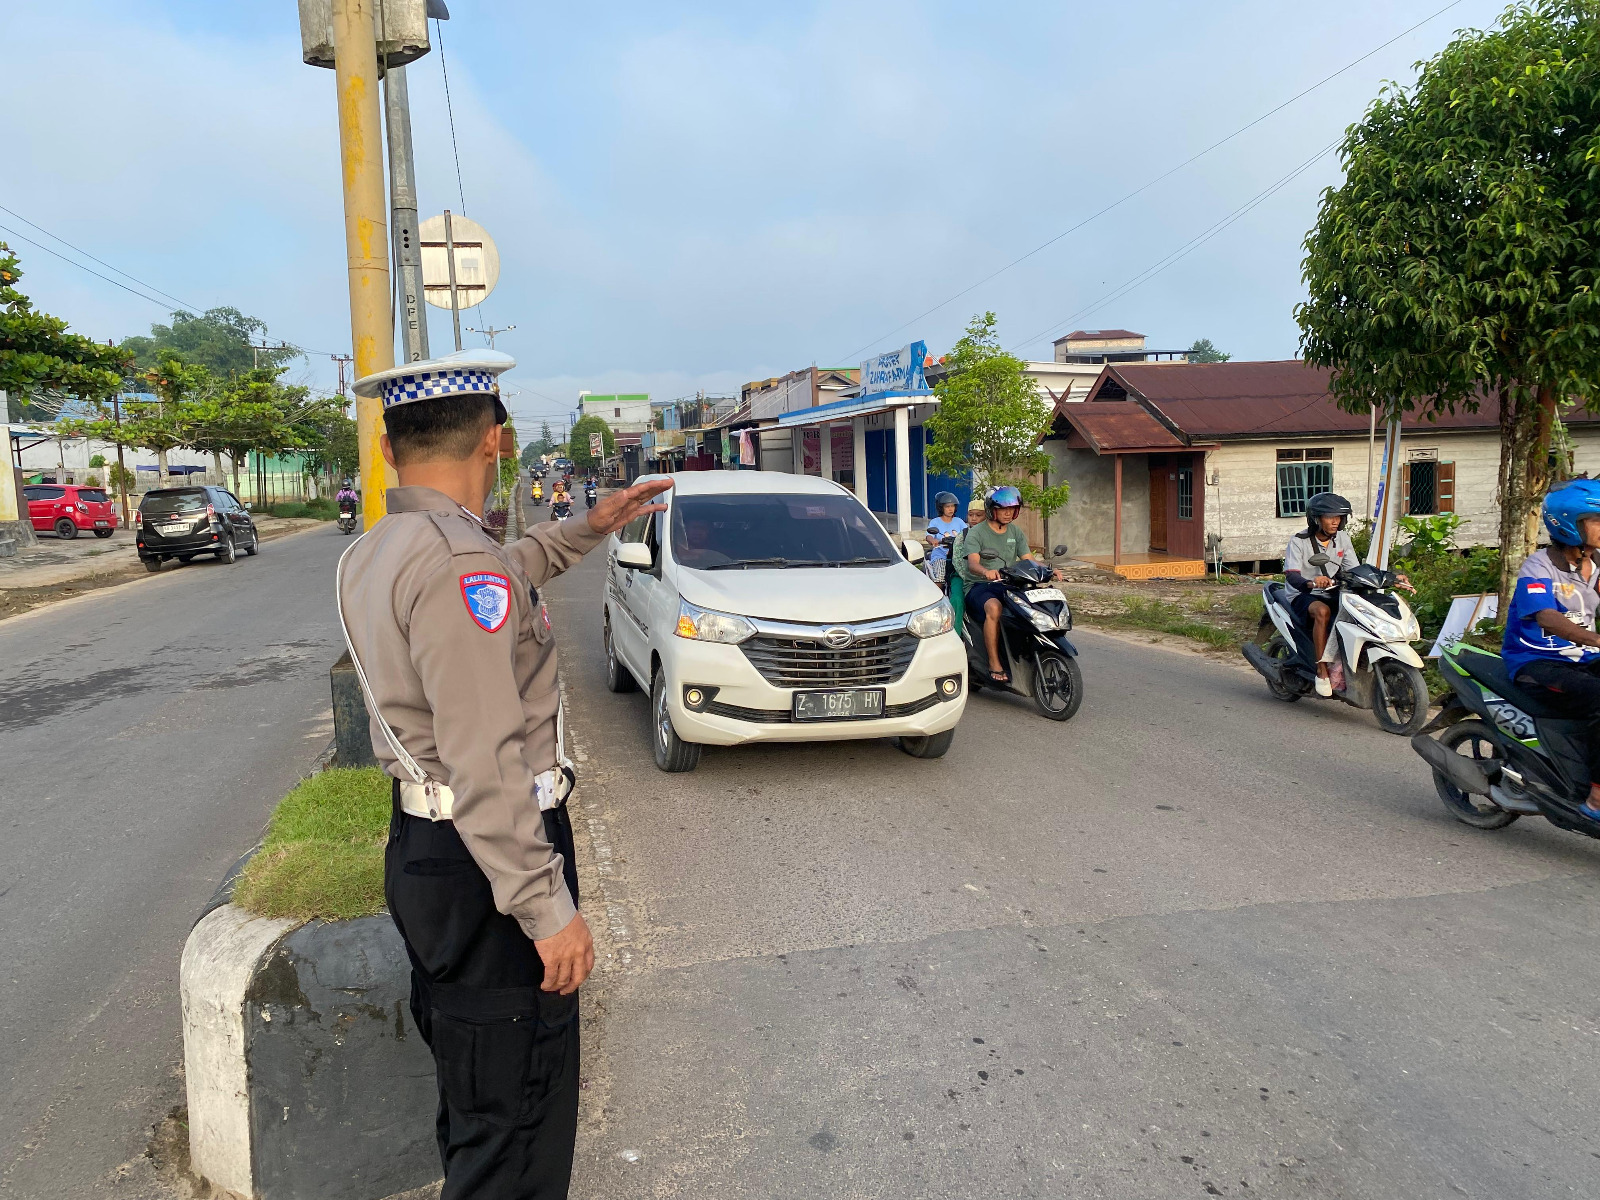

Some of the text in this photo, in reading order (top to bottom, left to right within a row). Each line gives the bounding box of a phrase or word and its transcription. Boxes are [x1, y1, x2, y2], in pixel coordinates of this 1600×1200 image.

[465, 574, 506, 586] LALU LINTAS
[798, 692, 880, 711] Z 1675 HV
